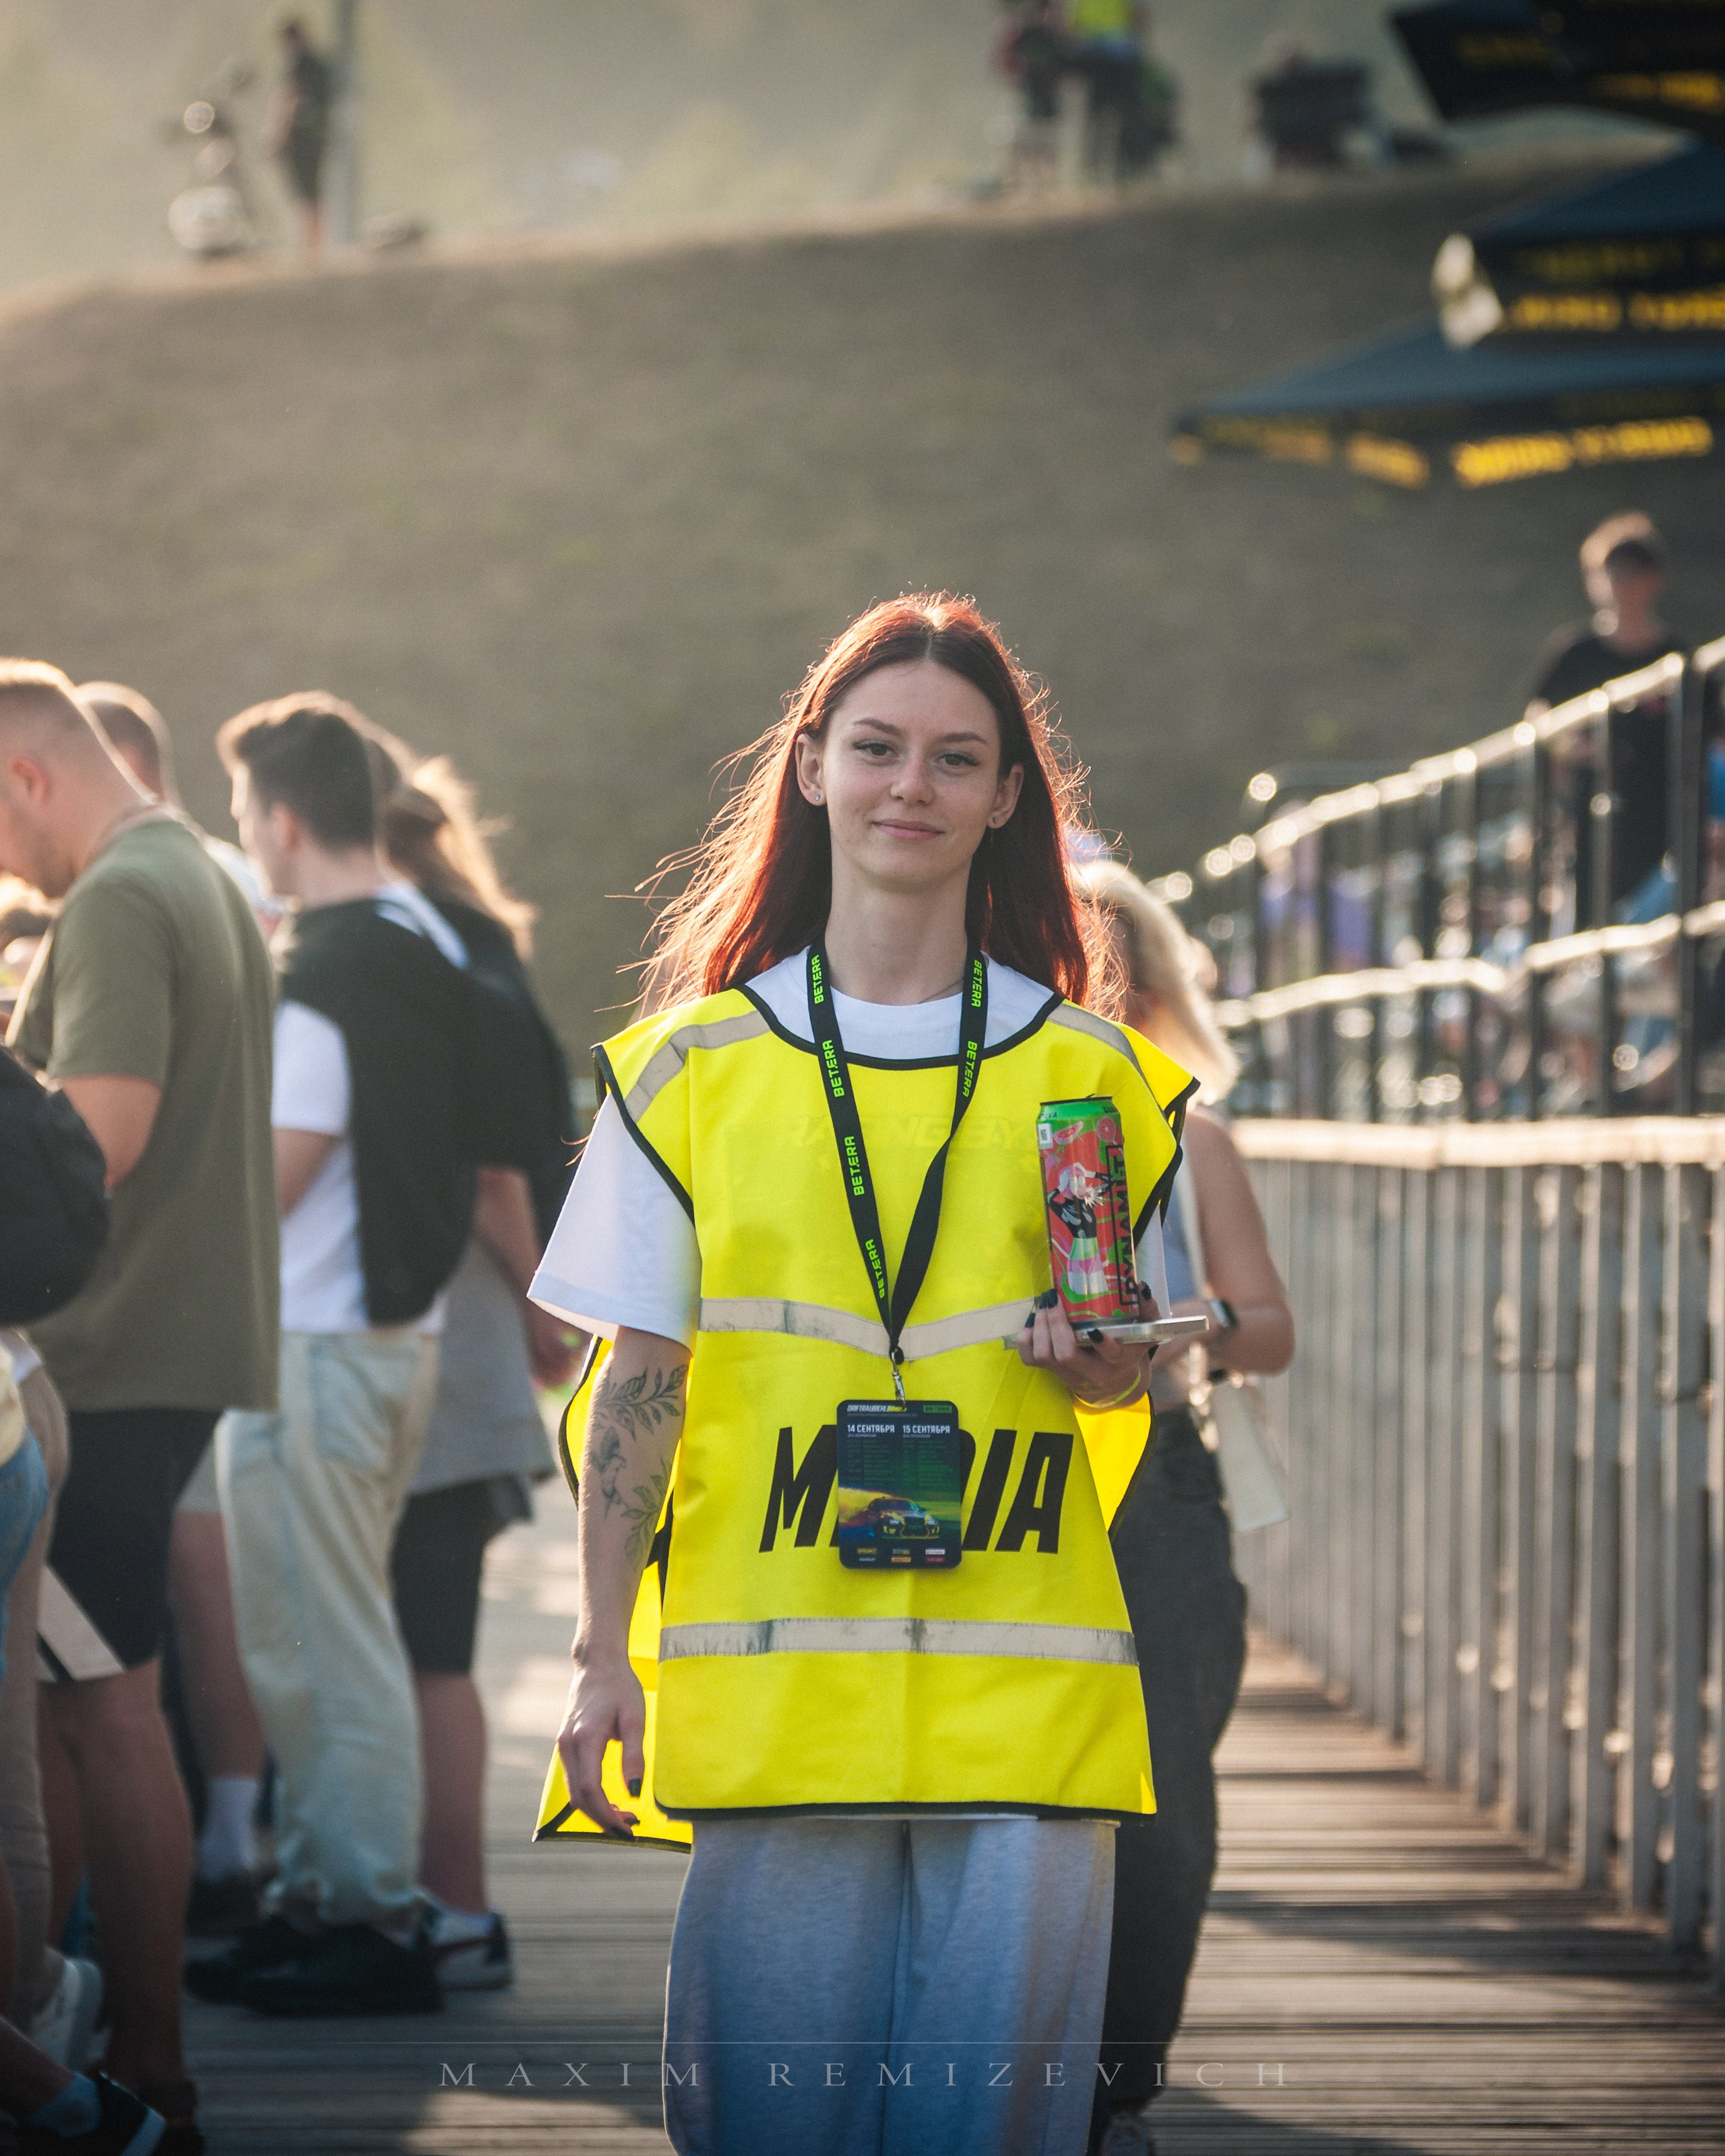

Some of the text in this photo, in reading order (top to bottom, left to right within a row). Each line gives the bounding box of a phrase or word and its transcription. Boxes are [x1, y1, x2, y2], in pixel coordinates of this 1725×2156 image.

[847, 1424, 895, 1433] 14 СЕНТЯБРЯ
[902, 1425, 950, 1434] 15 СЕНТЯБРЯ
[759, 1425, 1073, 1554] MIA
